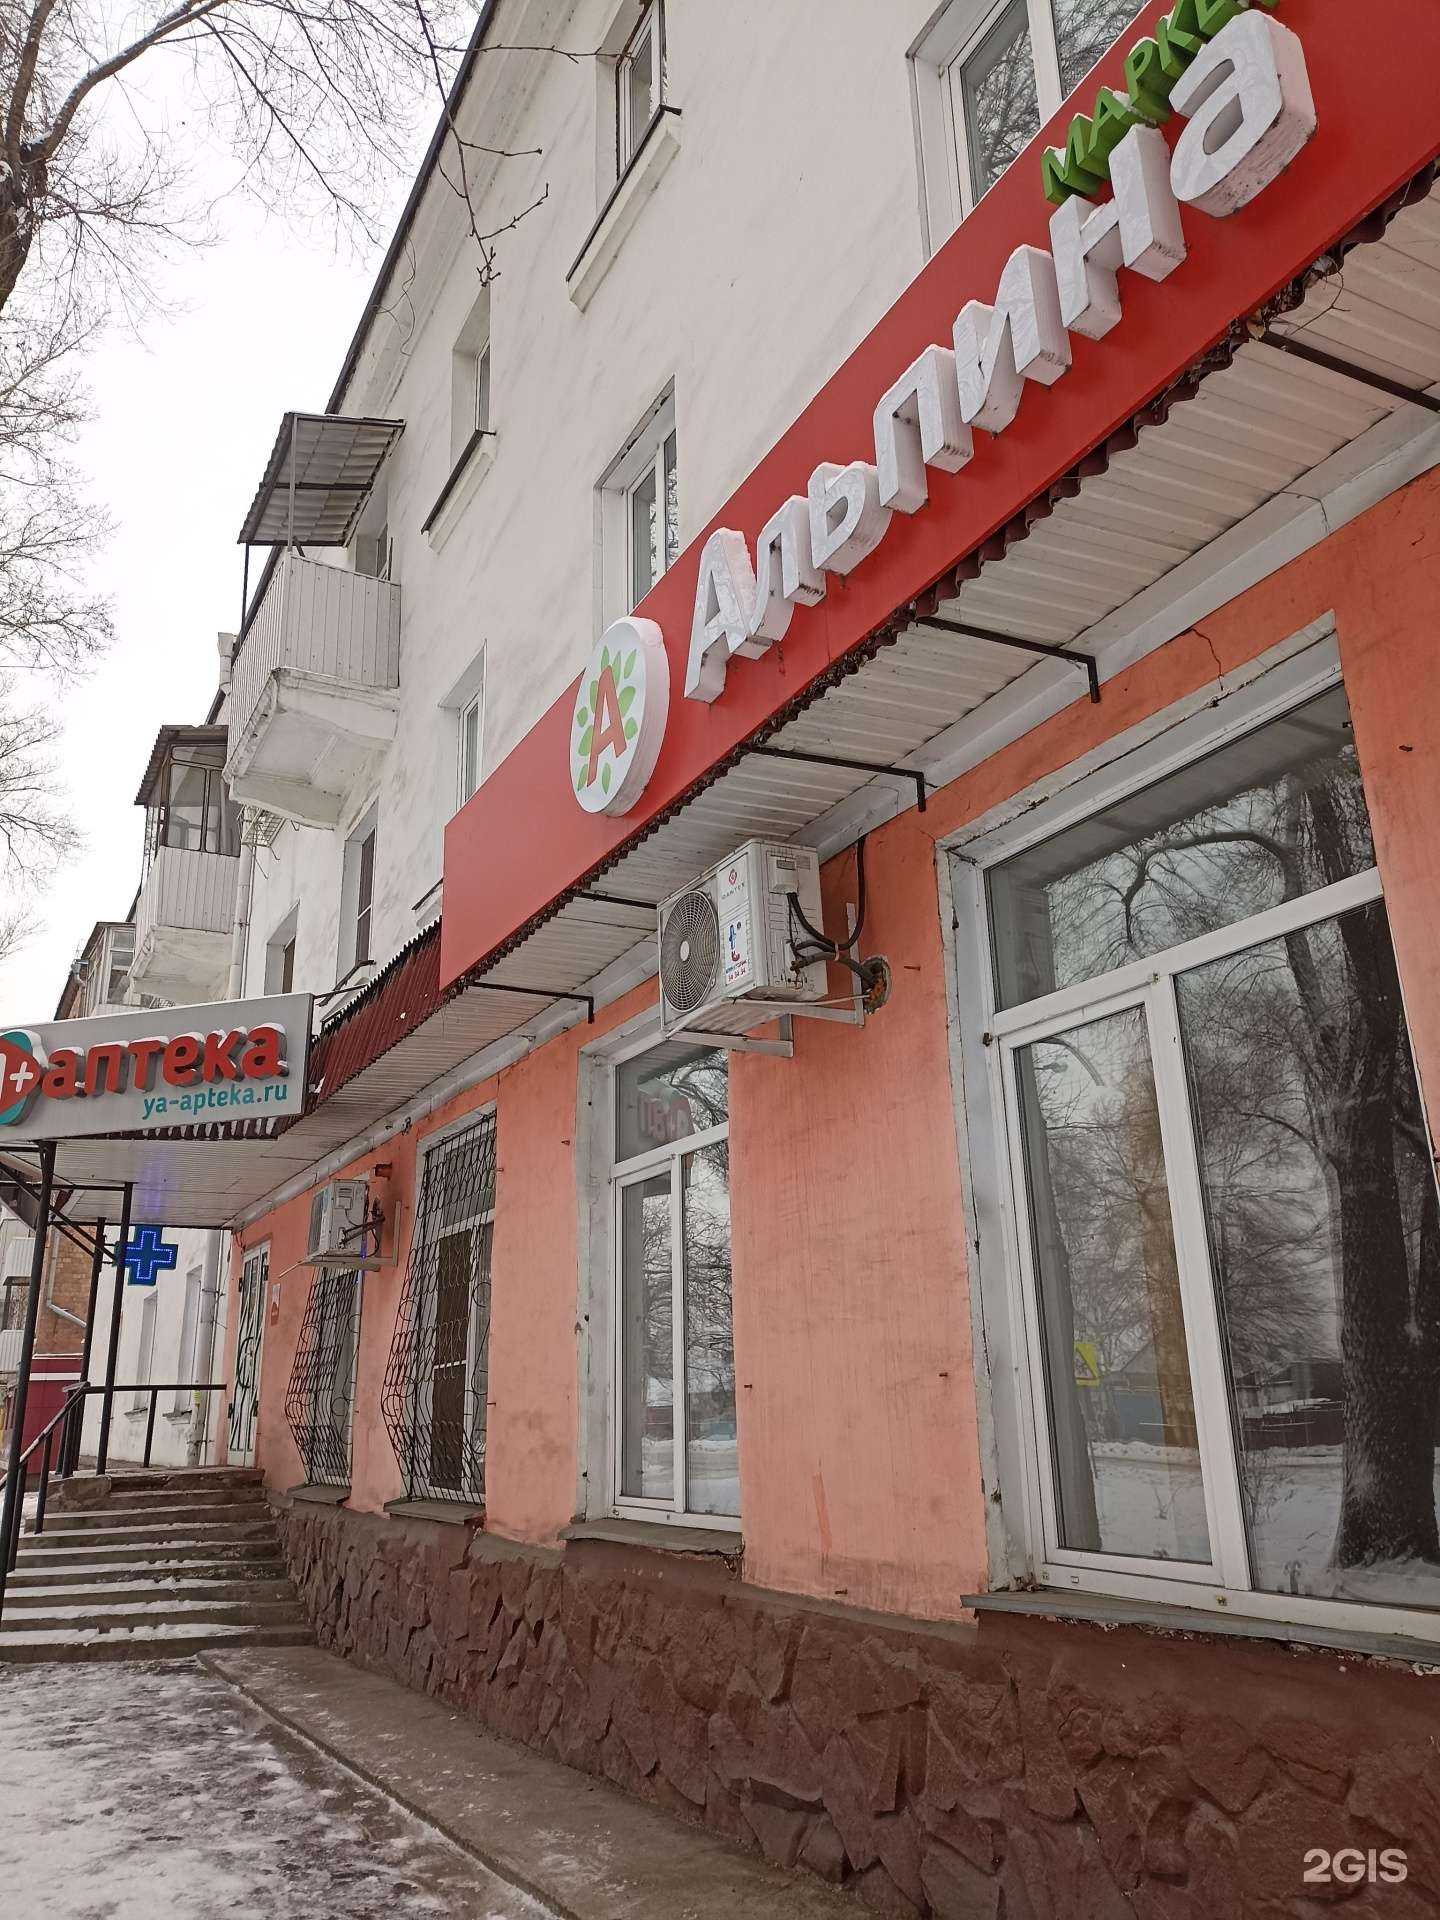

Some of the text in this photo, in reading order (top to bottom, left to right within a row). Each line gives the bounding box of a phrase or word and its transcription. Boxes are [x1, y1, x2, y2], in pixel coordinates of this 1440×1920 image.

[684, 8, 1318, 703] Альпина
[41, 1022, 290, 1098] аптека
[142, 1083, 288, 1120] ya-apteka.ru
